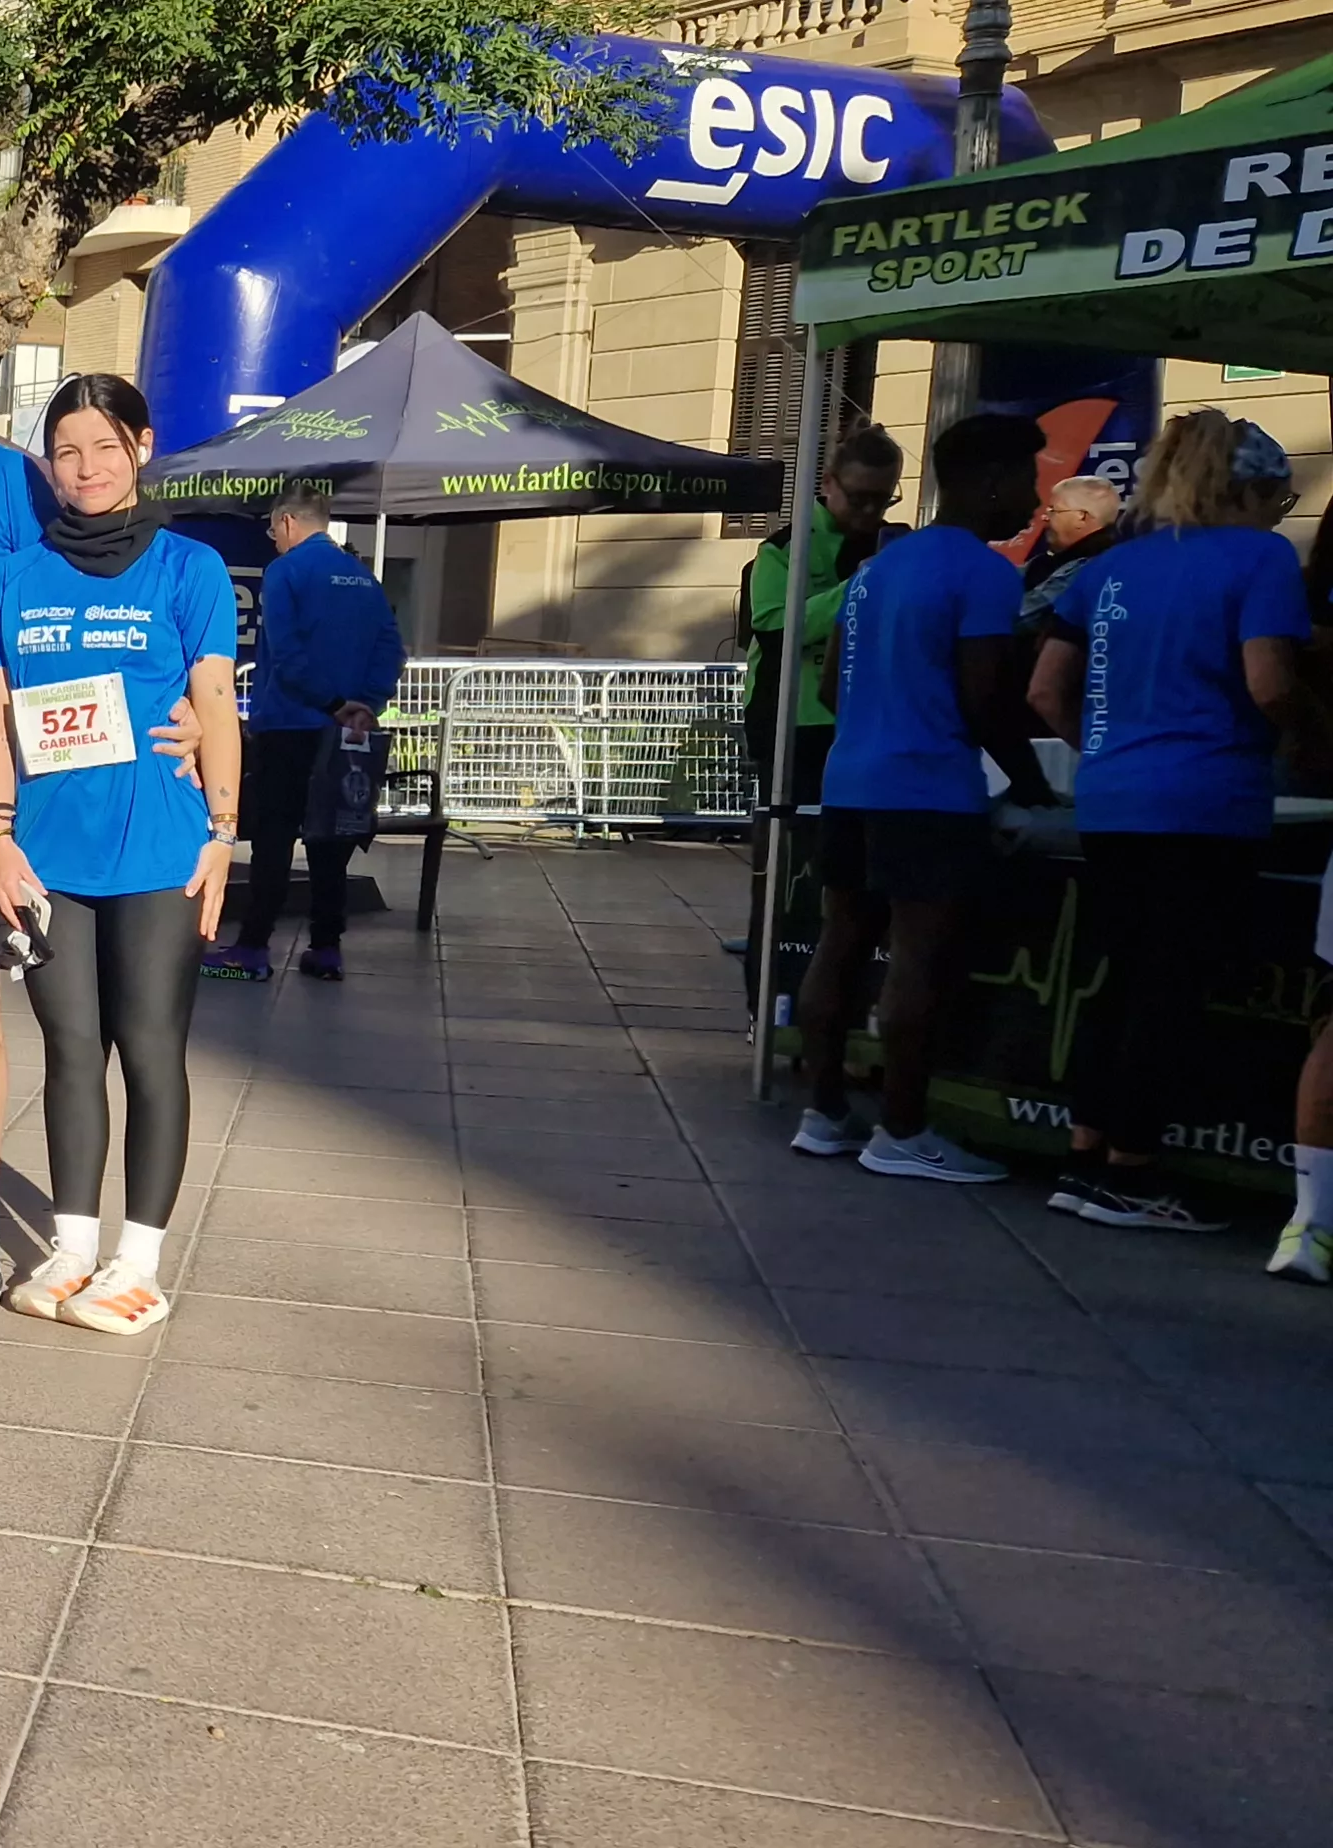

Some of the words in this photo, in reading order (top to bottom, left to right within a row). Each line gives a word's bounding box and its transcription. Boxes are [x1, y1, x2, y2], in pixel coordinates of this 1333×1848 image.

[832, 192, 1091, 257] FARTLECK
[1116, 218, 1257, 279] DE
[868, 241, 1038, 292] SPORT
[442, 461, 728, 498] www.fartlecksport.com
[100, 604, 153, 622] kablex
[17, 625, 72, 646] NEXT
[83, 630, 126, 642] HOME
[41, 703, 98, 735] 527
[39, 731, 109, 751] GABRIELA
[52, 748, 73, 763] 8K
